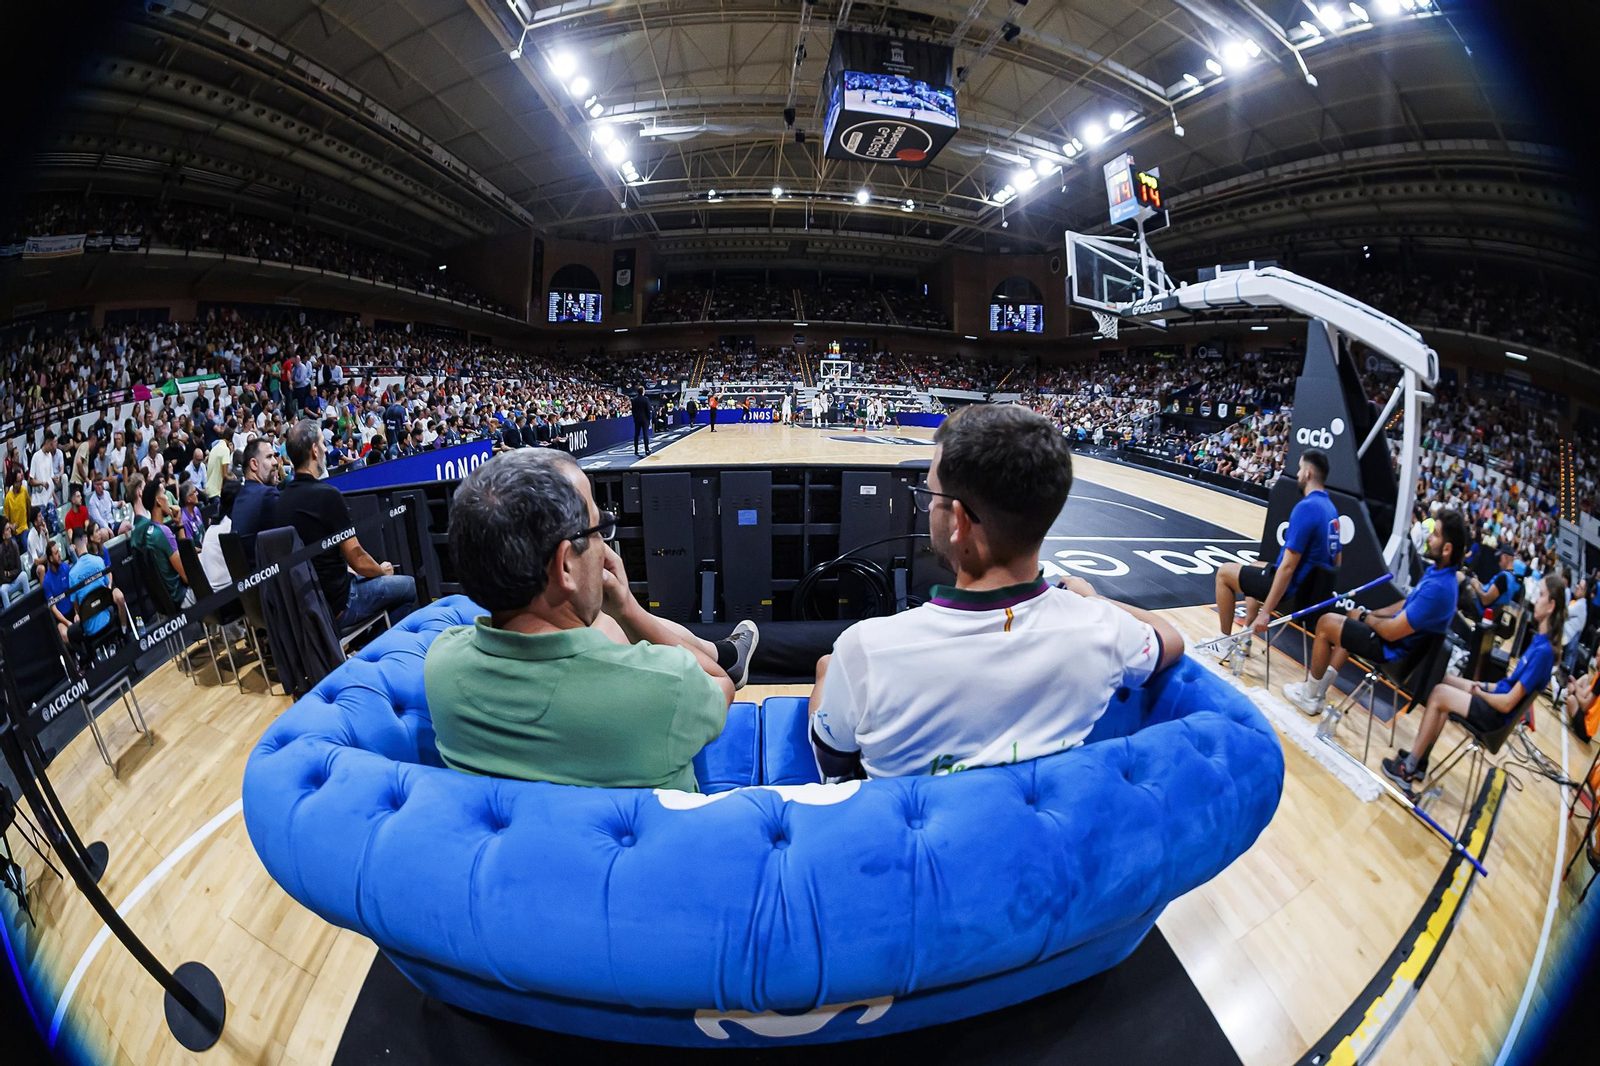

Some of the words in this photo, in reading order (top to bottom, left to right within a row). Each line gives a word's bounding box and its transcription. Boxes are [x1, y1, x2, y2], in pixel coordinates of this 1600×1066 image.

[866, 127, 890, 156] endesa
[1141, 184, 1161, 207] 14
[1132, 302, 1163, 316] endesa
[1296, 427, 1334, 450] acb
[321, 526, 356, 550] @ACBCOM
[237, 563, 280, 592] @ACBCOM
[139, 613, 188, 651] @ACBCOM
[41, 678, 90, 722] @ACBCOM
